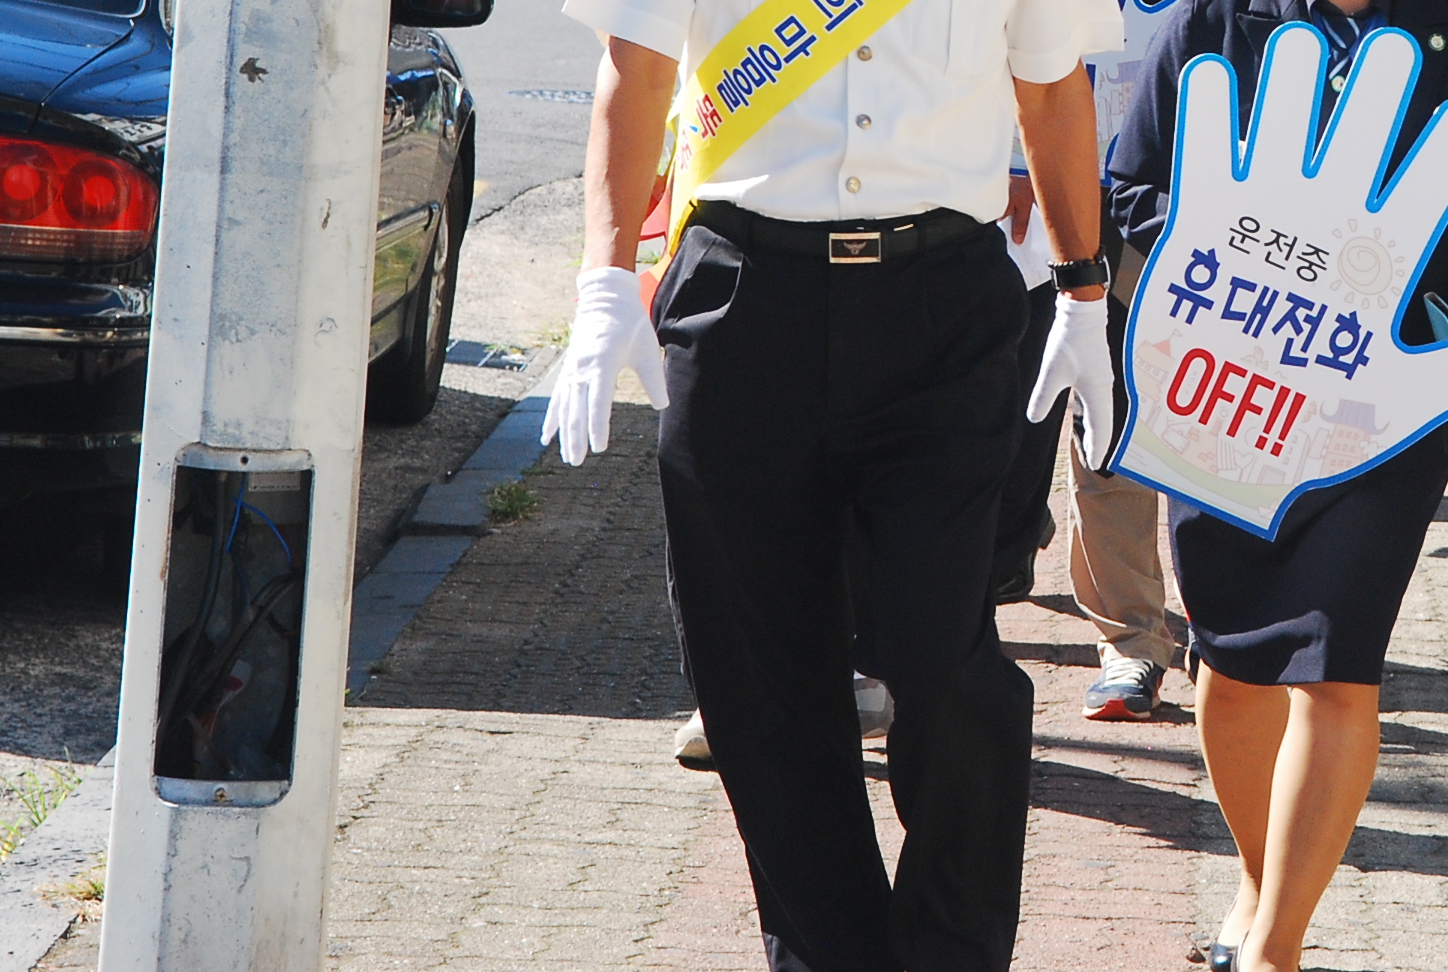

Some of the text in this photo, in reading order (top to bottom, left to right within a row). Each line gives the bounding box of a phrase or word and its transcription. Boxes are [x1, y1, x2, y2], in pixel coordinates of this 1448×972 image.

[715, 14, 819, 114] 마음을
[1228, 215, 1330, 283] 운전중
[1166, 247, 1375, 381] 휴대전화
[1166, 348, 1308, 458] OFF!!
